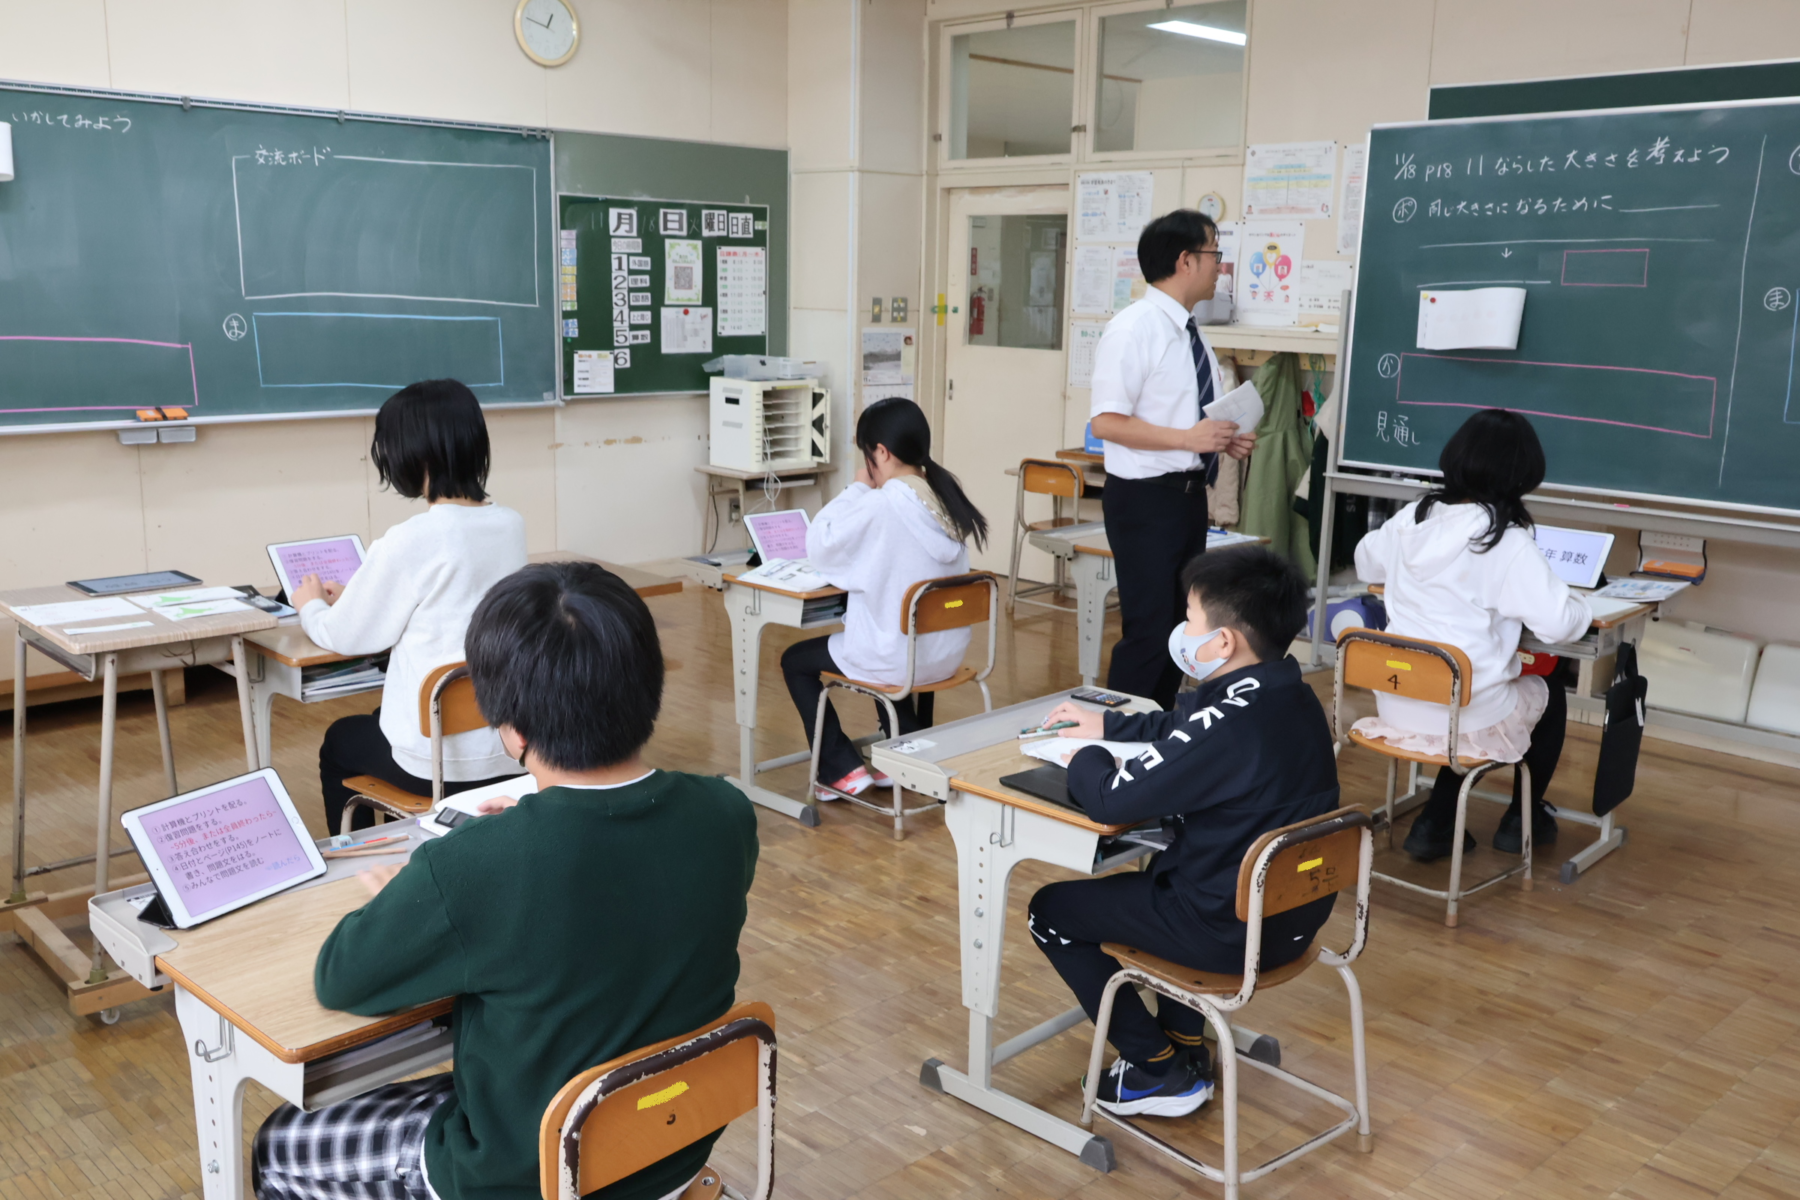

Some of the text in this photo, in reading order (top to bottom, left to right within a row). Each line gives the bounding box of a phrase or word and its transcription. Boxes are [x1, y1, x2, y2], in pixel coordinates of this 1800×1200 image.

[11, 111, 132, 133] いかしてみよう
[254, 144, 331, 167] 交流ボード
[612, 211, 635, 234] 月
[662, 210, 684, 232] 日
[704, 212, 726, 233] 曜日
[730, 214, 752, 236] 日直
[613, 255, 626, 272] 1
[613, 274, 627, 290] 2
[613, 291, 627, 308] 3
[613, 309, 627, 325] 4
[615, 329, 628, 345] 5
[614, 350, 628, 367] 6
[1376, 410, 1420, 448] 見通し
[1559, 550, 1588, 566] 算数
[1387, 674, 1401, 690] 4
